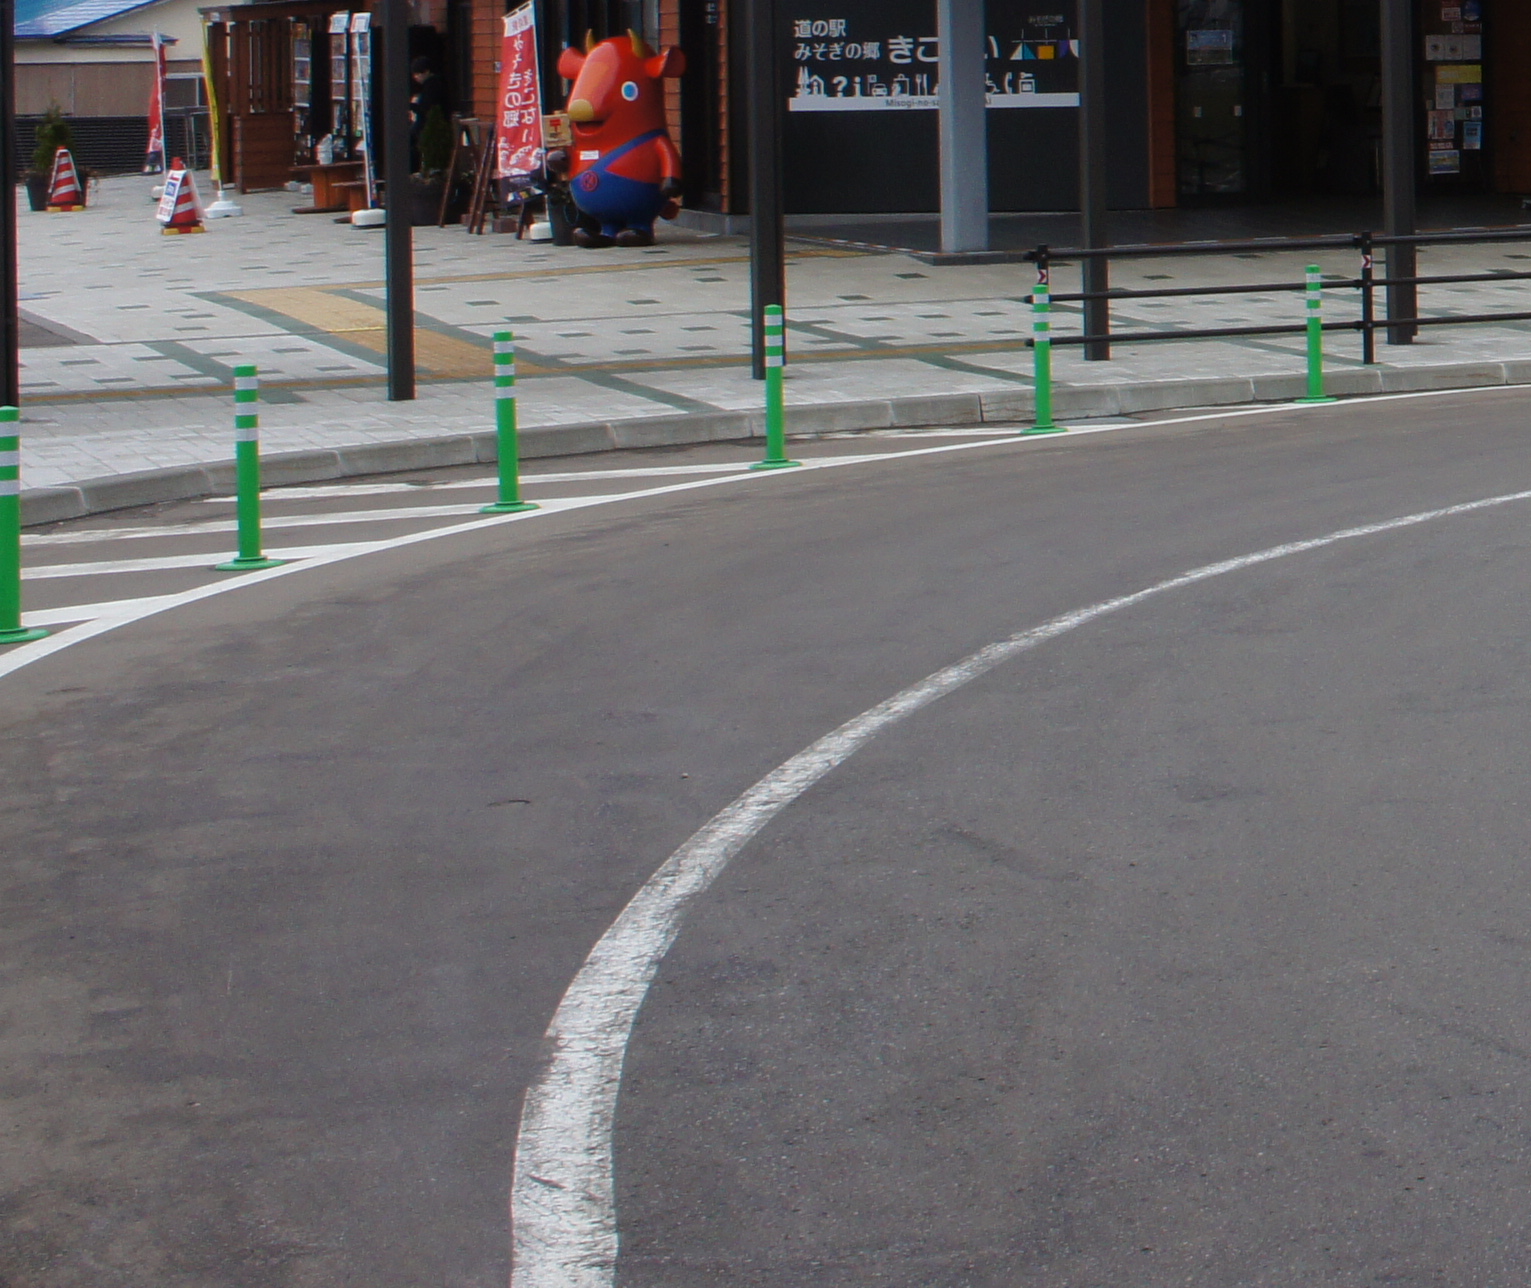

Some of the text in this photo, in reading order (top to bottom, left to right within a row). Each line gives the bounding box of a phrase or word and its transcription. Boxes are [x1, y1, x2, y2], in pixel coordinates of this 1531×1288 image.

[794, 18, 846, 39] 道の駅
[794, 35, 1000, 64] みそぎの郷 きこい
[886, 99, 940, 109] Misogi-no-sa
